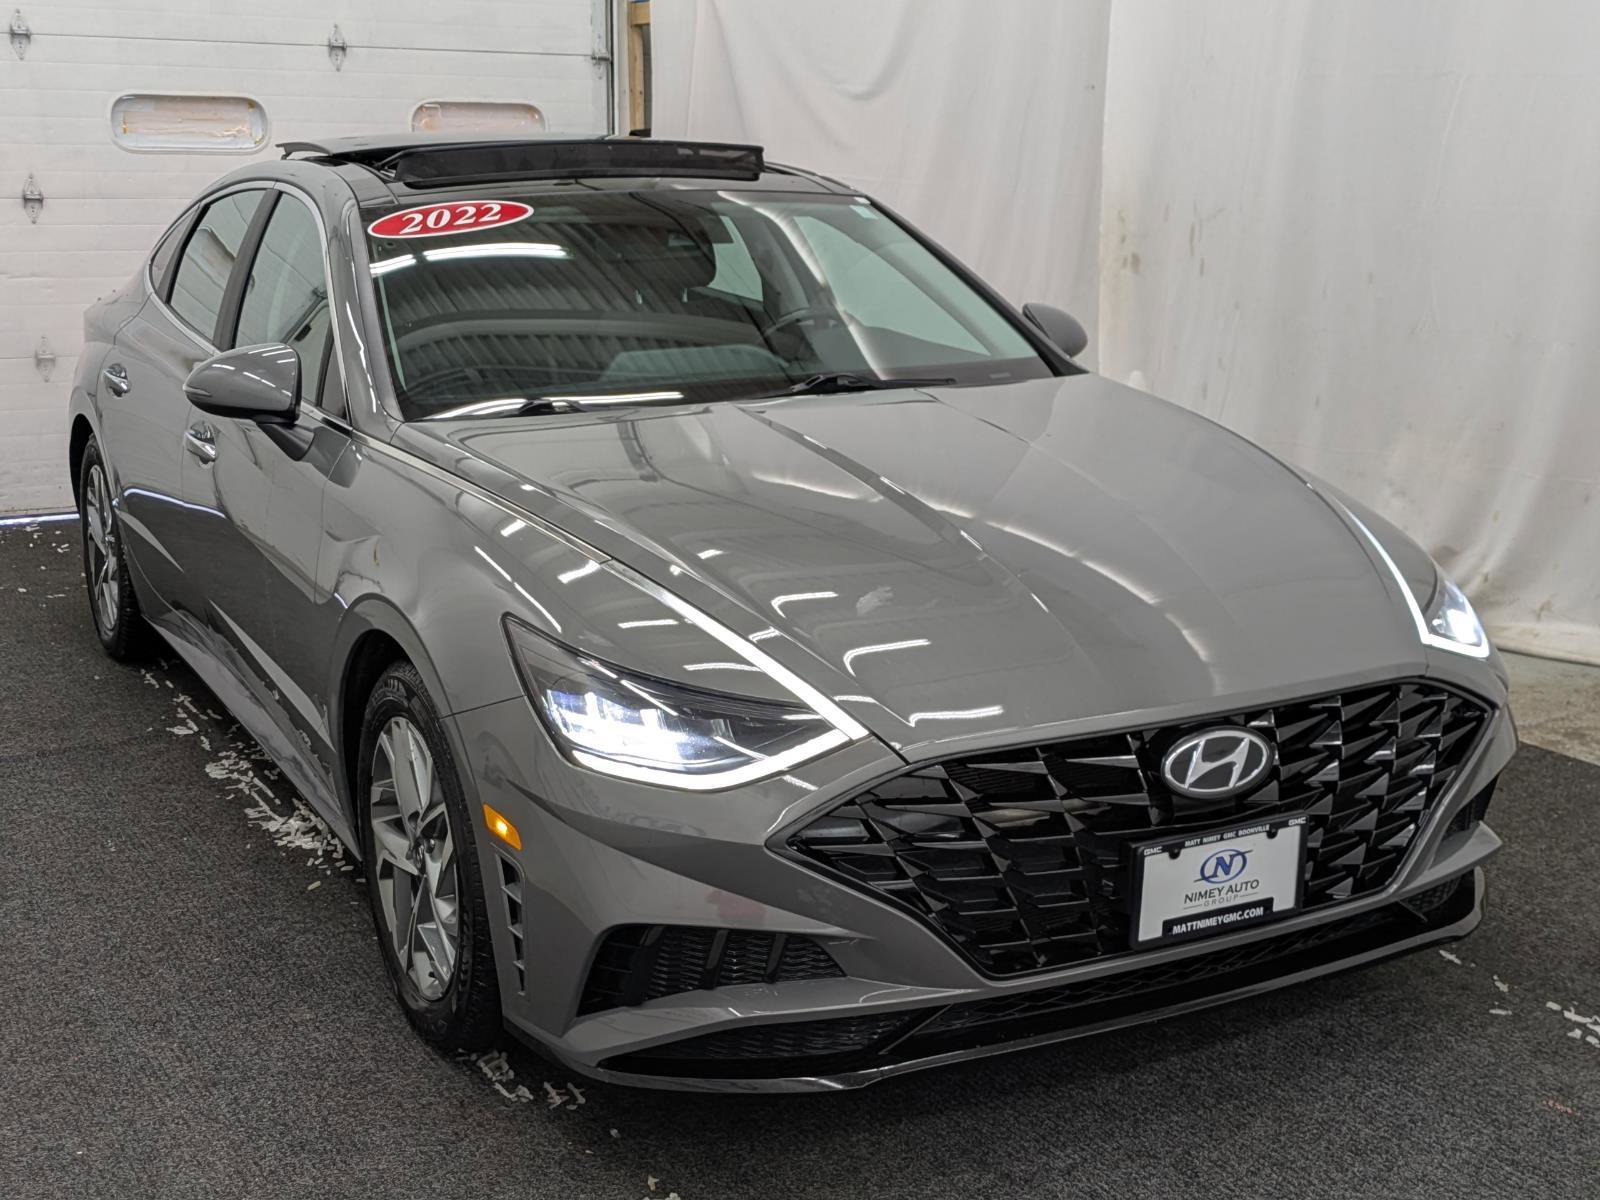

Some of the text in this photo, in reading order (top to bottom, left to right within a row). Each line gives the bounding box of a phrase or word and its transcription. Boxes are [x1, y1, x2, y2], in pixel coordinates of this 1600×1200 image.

[399, 203, 502, 234] 2022
[1288, 817, 1307, 826] GMC
[1184, 824, 1270, 847] MATT NIMEY GMC BOONVILLE
[1144, 846, 1163, 856] GMC
[1184, 879, 1260, 904] NIMEY AUTO
[1203, 894, 1239, 907] GROUP
[1172, 907, 1264, 935] MATTNIMEYGMC.COM
